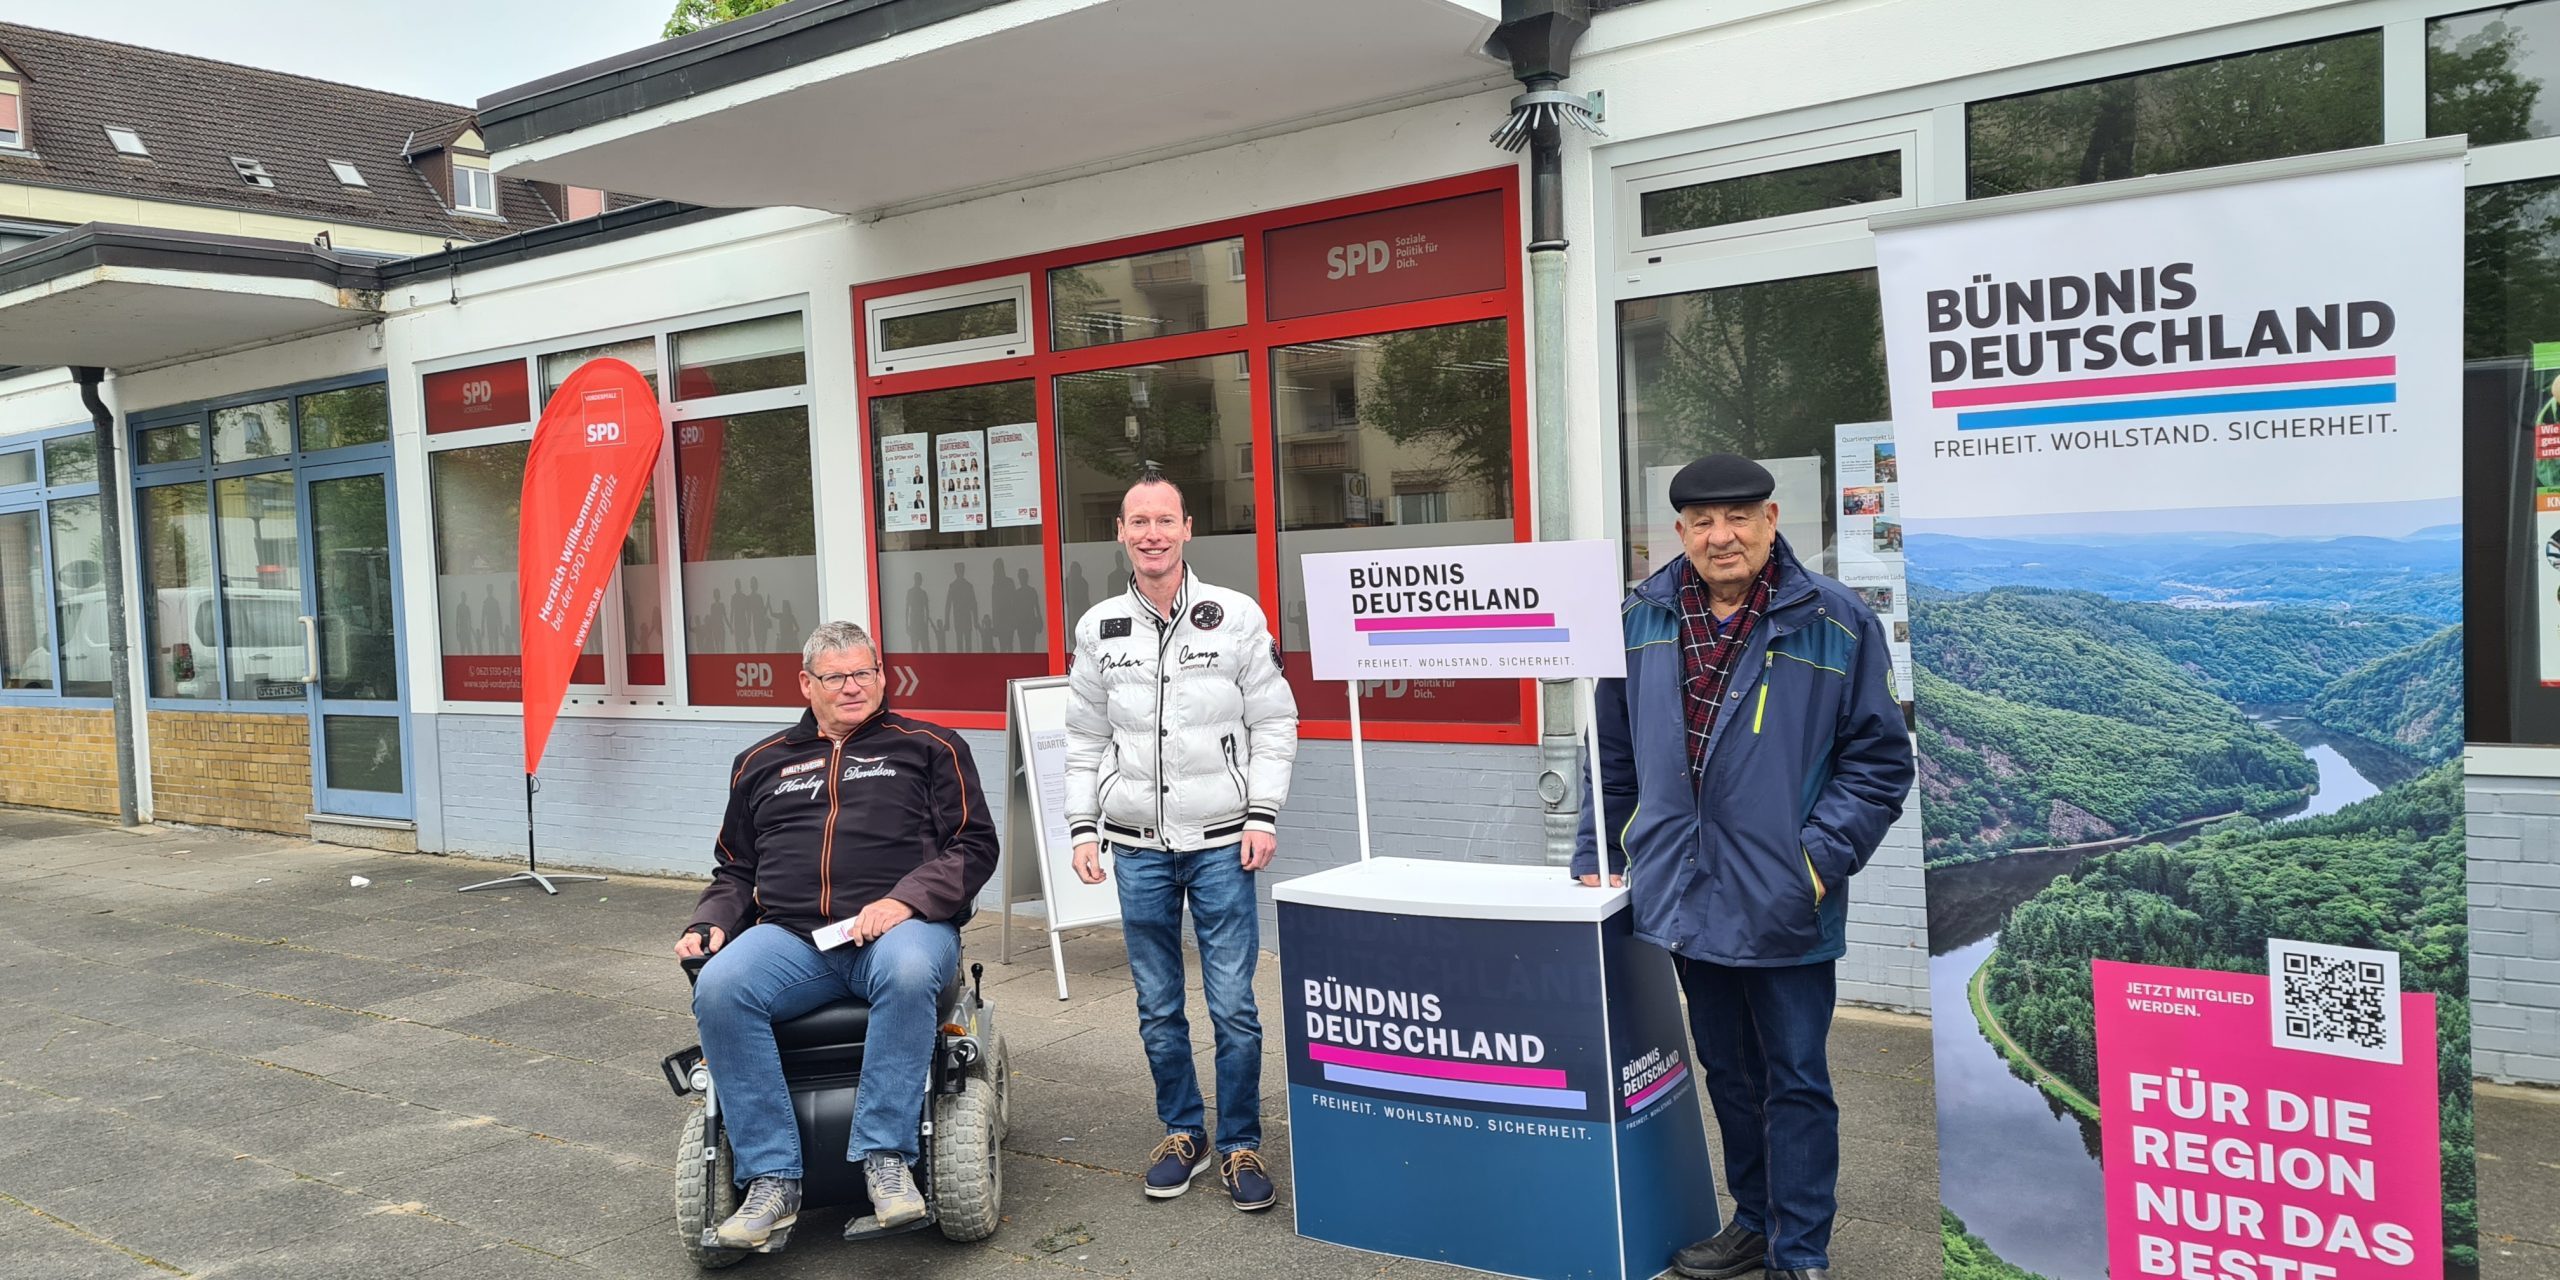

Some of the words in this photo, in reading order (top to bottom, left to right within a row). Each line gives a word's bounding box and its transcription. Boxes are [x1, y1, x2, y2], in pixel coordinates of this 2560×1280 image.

[1395, 232, 1426, 247] Soziale
[1396, 244, 1424, 258] Politik
[1425, 242, 1438, 254] für
[1326, 240, 1391, 280] SPD
[1396, 258, 1419, 269] Dich.
[1927, 263, 2197, 333] BÜNDNIS
[1929, 300, 2396, 383] DEUTSCHLAND
[462, 380, 492, 405] SPD
[586, 422, 620, 443] SPD
[1934, 434, 2042, 458] FREIHEIT.
[2050, 424, 2217, 451] WOHLSTAND.
[2228, 413, 2398, 441] SICHERHEIT.
[2541, 425, 2559, 434] Wie
[2541, 436, 2560, 447] gesu
[538, 565, 567, 622] Herzlich
[560, 473, 603, 564] Willkommen
[551, 606, 565, 632] bei
[559, 585, 575, 609] der
[569, 553, 586, 584] SPD
[580, 474, 618, 553] Vorderpfalz
[1350, 562, 1465, 589] BÜNDNIS
[1352, 587, 1540, 614] DEUTSCHLAND
[573, 586, 604, 648] www.SPD.DE
[1178, 645, 1219, 668] Camp
[1357, 658, 1413, 668] FREIHEIT.
[1419, 657, 1493, 667] WOHLSTAND.
[1499, 656, 1575, 667] SICHERHEIT.
[735, 662, 773, 688] SPD
[736, 689, 774, 698] VORDERPFALZ
[1345, 679, 1408, 698] PD
[1413, 688, 1436, 699] Dich.
[842, 762, 896, 781] Davidson
[774, 775, 825, 800] Harley
[1304, 975, 1443, 1022] BÜNDNIS
[2126, 981, 2173, 998] JETZT
[2175, 985, 2255, 1006] MITGLIED
[2127, 998, 2201, 1017] WERDEN.
[1306, 1011, 1545, 1064] DEUTSCHLAND
[1622, 1047, 1660, 1082] BÜNDNIS
[1623, 1050, 1680, 1097] DEUTSCHLAND
[1312, 1094, 1377, 1117] FREIHEIT.
[1384, 1106, 1480, 1130] WOHLSTAND.
[1487, 1119, 1592, 1141] SICHERHEIT.
[2129, 1067, 2251, 1127] FÜR
[2267, 1089, 2373, 1146] DIE
[2131, 1125, 2376, 1202] REGION
[2135, 1182, 2266, 1241] NUR
[2281, 1203, 2415, 1267] DAS
